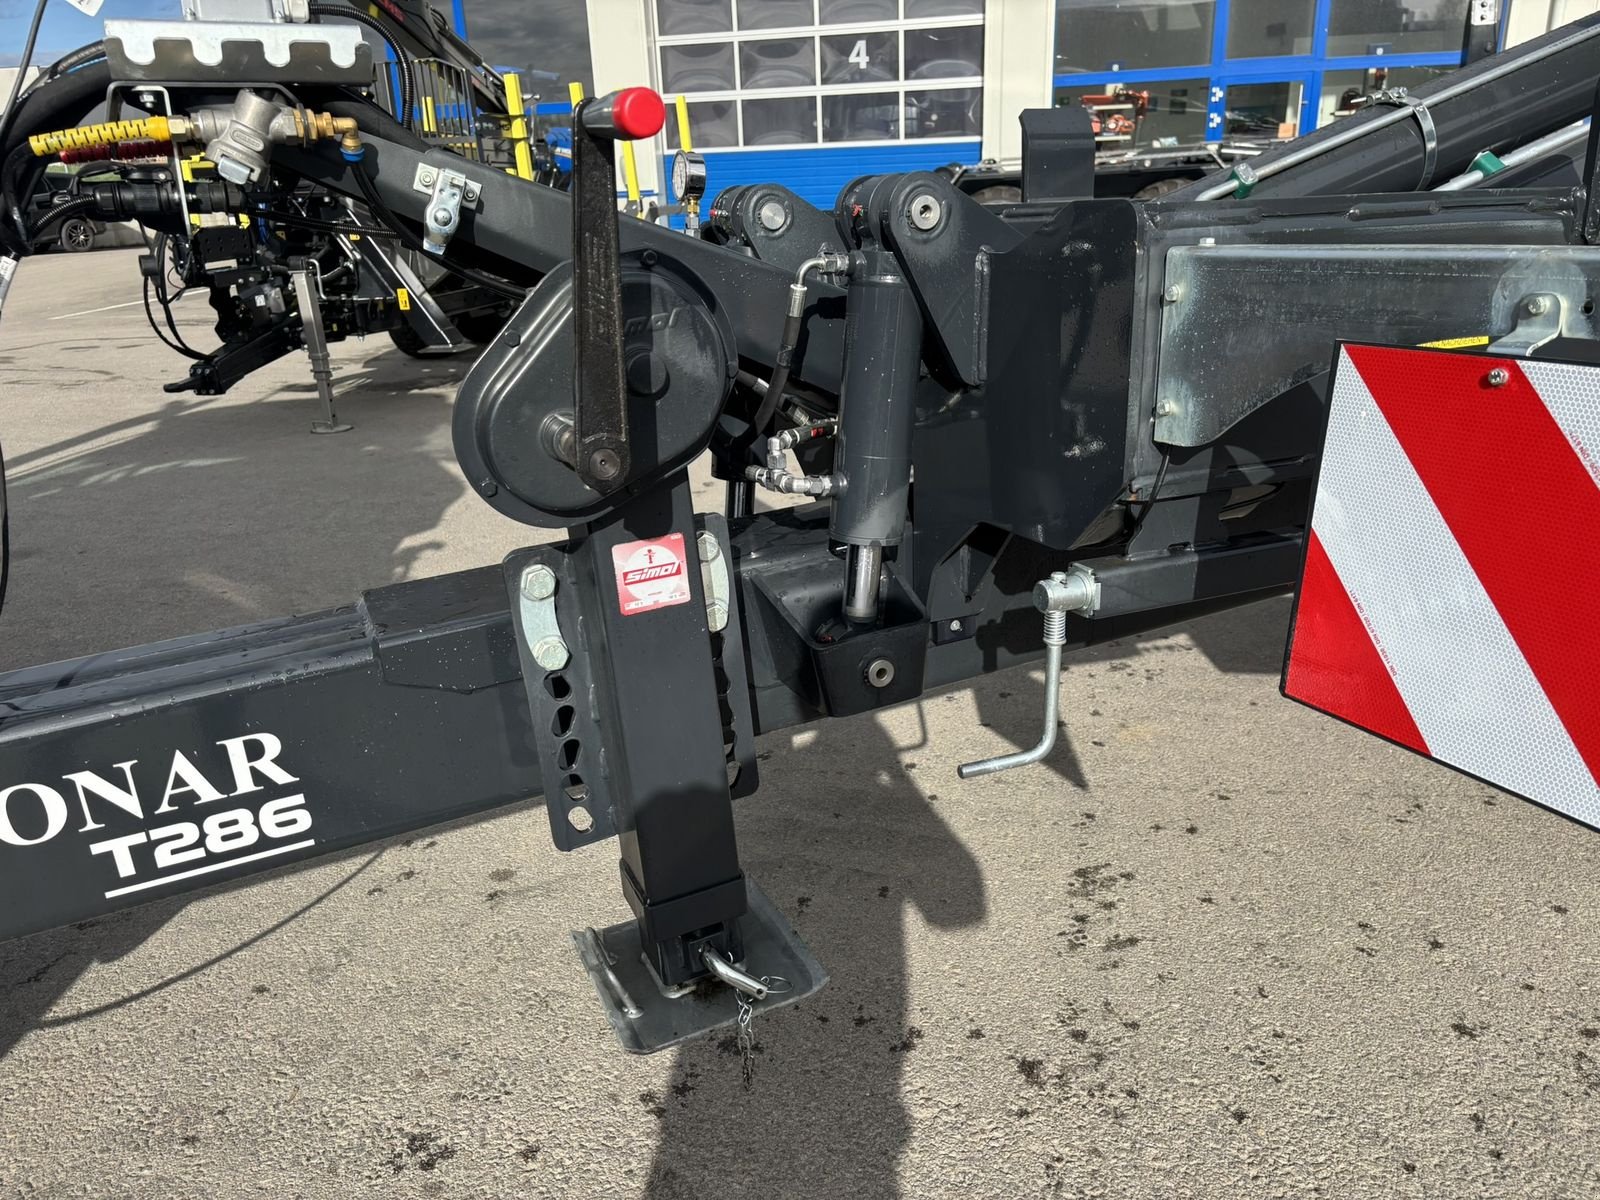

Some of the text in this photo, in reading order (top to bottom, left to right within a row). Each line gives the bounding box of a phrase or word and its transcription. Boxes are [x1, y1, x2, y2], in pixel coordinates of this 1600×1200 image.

[849, 40, 870, 69] 4
[1356, 602, 1365, 614] DIN
[1373, 633, 1381, 645] DIN
[1389, 664, 1398, 677] DIN
[0, 732, 300, 846] ONAR
[89, 793, 313, 878] T286
